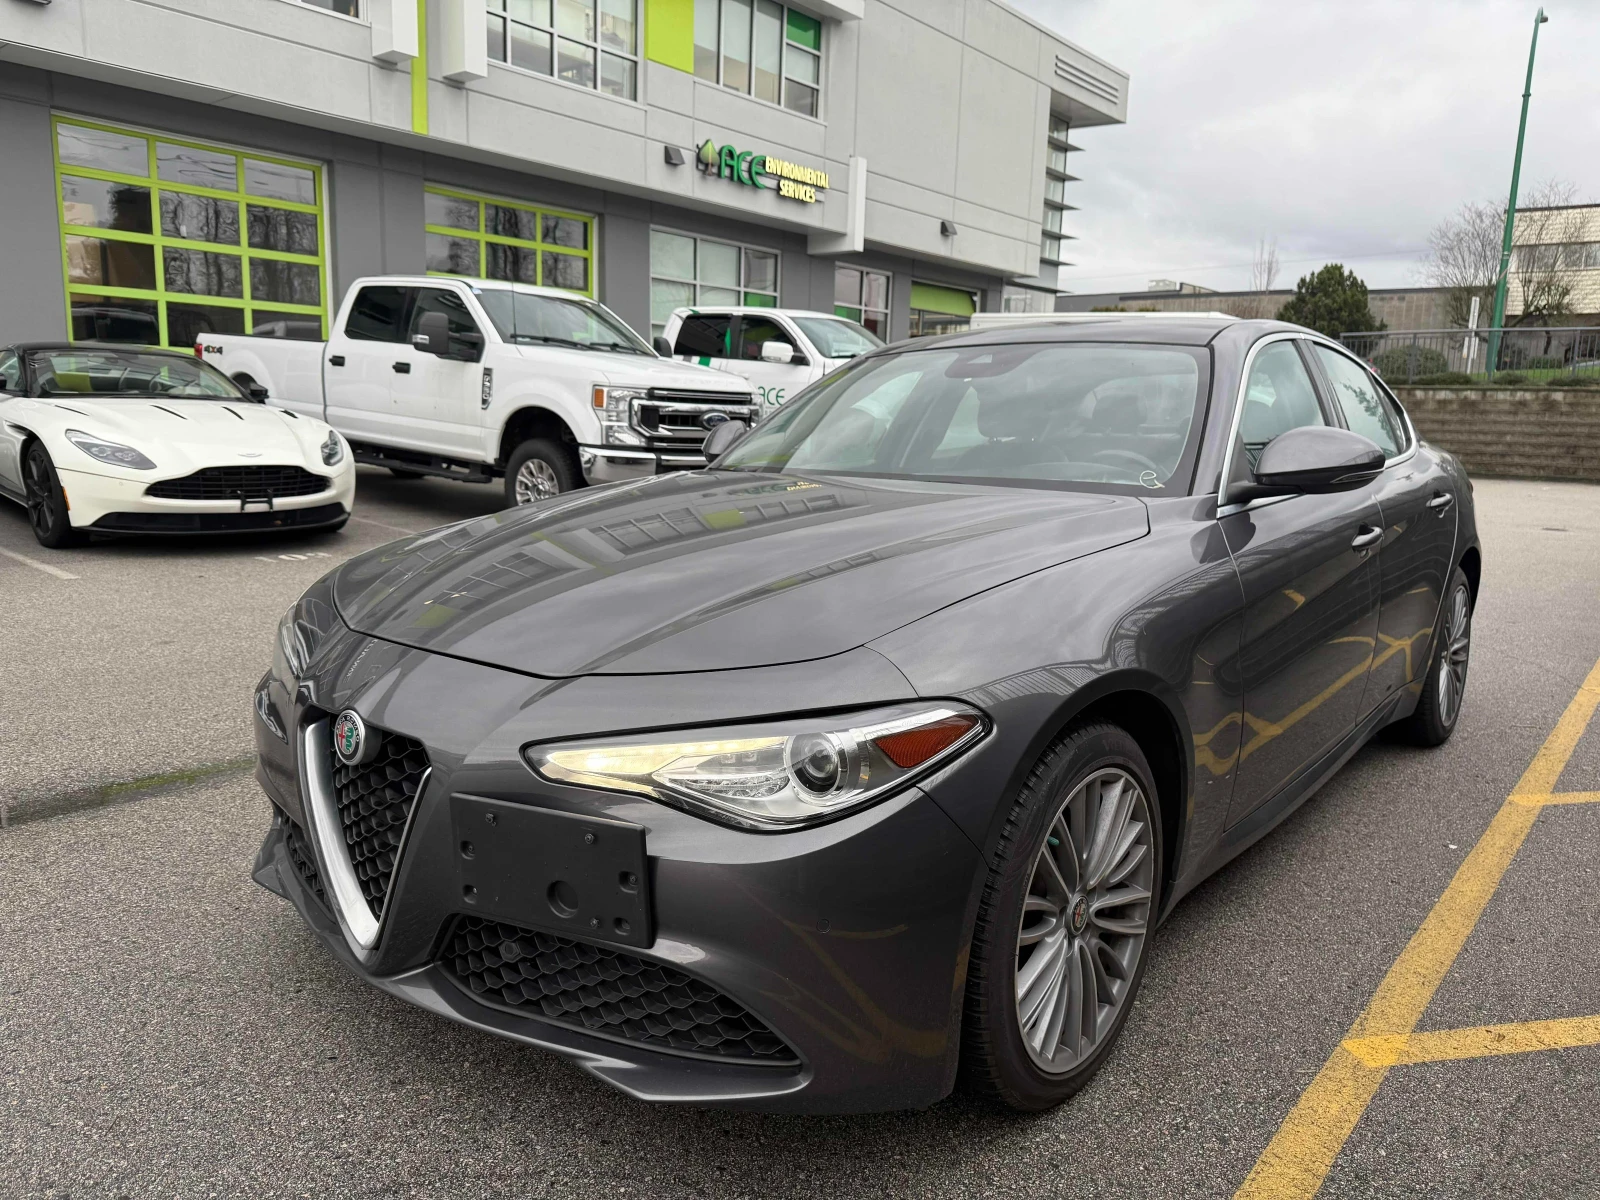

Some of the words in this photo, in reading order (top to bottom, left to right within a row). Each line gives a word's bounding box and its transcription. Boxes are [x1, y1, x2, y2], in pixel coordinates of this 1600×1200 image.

[719, 144, 767, 190] ACE
[765, 155, 830, 189] ENVIRONMENTAL
[778, 178, 816, 204] SERVICES
